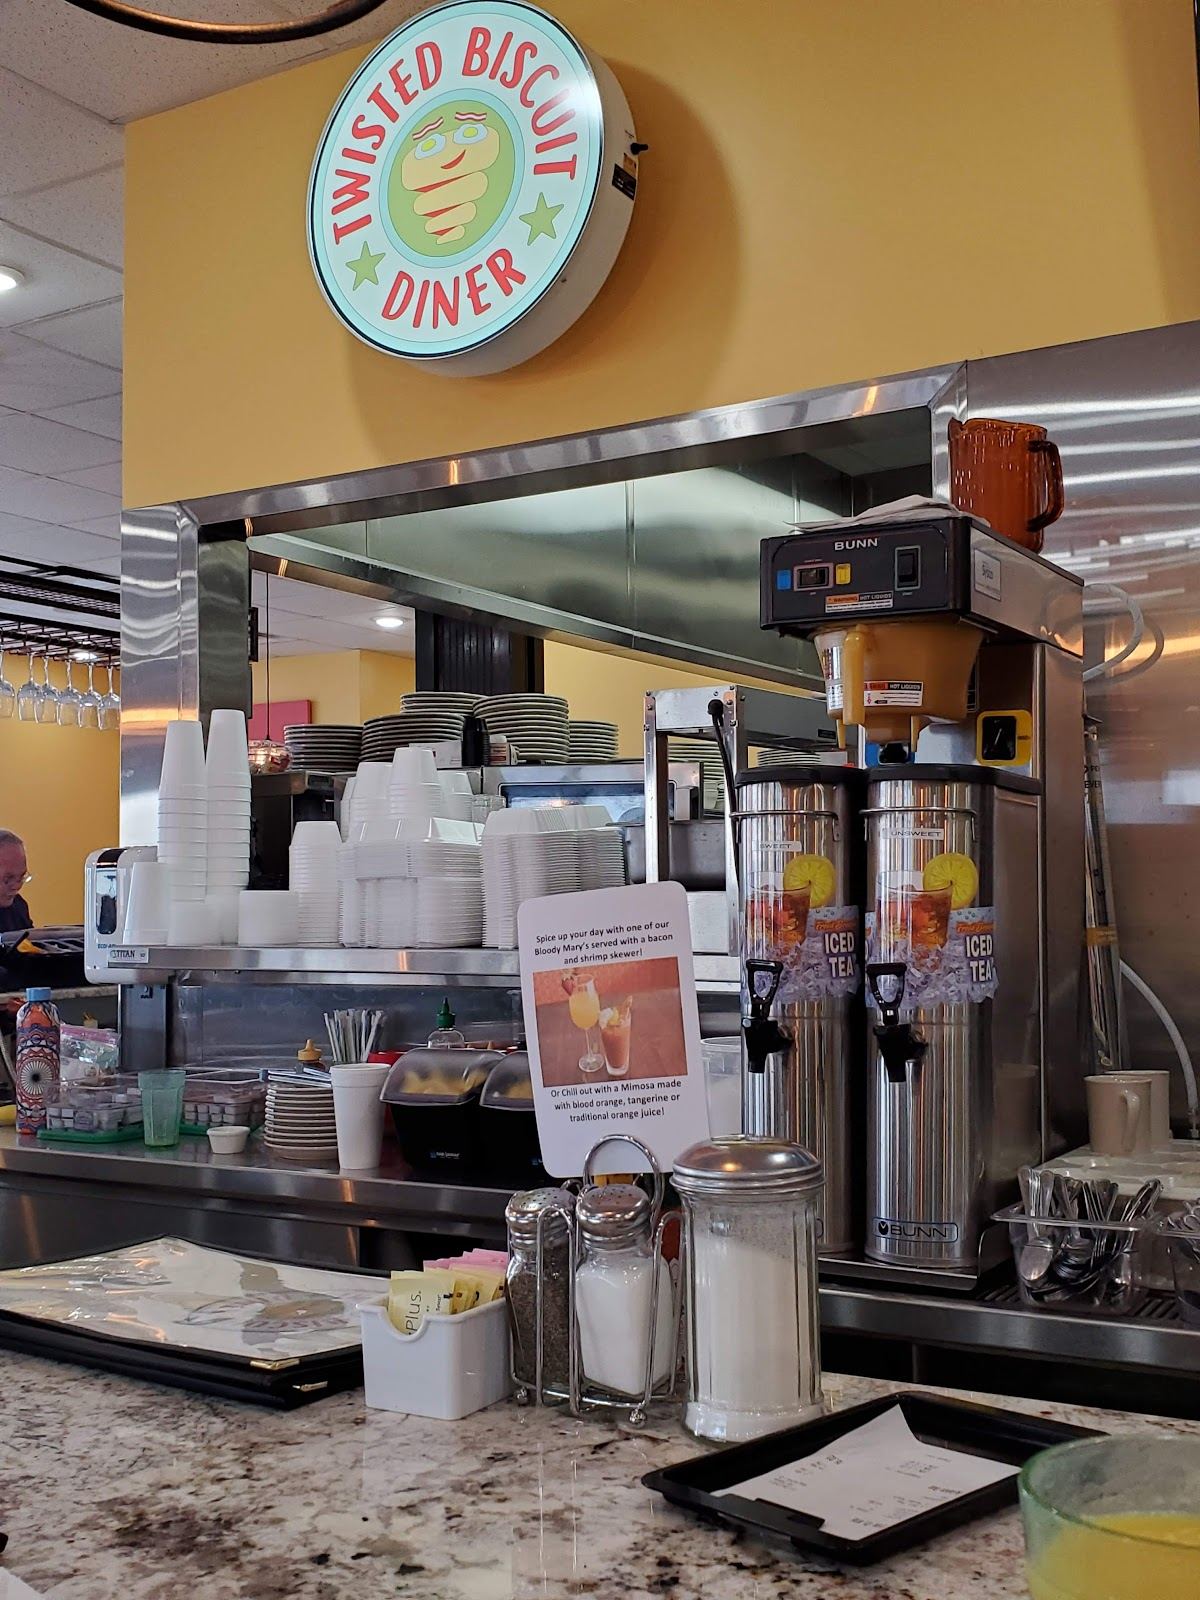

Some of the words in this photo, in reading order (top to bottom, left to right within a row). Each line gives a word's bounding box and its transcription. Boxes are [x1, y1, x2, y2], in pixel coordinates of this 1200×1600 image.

[331, 41, 442, 245] TWISTED
[462, 26, 578, 181] BISCUIT
[381, 248, 527, 329] DINER
[834, 537, 879, 551] BUNN
[890, 830, 942, 838] UNSWEET
[536, 934, 556, 944] Spice
[558, 932, 568, 942] up
[570, 930, 588, 941] your
[590, 927, 604, 938] day
[606, 925, 625, 935] with
[626, 924, 642, 932] one
[644, 921, 653, 930] of
[654, 921, 670, 929] our
[824, 931, 855, 955] ICED
[534, 945, 561, 956] Bloody
[562, 941, 590, 952] Mary's
[591, 938, 618, 949] served
[619, 936, 639, 945] with
[640, 936, 646, 944] a
[647, 933, 674, 942] bacon
[564, 955, 579, 965] and
[580, 953, 608, 963] shrimp
[609, 947, 643, 960] skewer!
[965, 933, 994, 958] ICED
[828, 956, 855, 979] TEA
[969, 958, 993, 983] TEA
[550, 1089, 560, 1098] Or
[561, 1087, 578, 1097] Chill
[579, 1087, 593, 1095] out
[594, 1084, 612, 1094] with
[613, 1085, 619, 1093] a
[621, 1082, 655, 1092] Mimosa
[657, 1078, 682, 1089] made
[554, 1101, 571, 1110] with
[572, 1099, 594, 1109] blood
[595, 1098, 626, 1108] orange,
[627, 1094, 669, 1105] tangerine
[569, 1110, 609, 1122] traditional
[610, 1111, 639, 1120] orange
[640, 1106, 665, 1119] juice!
[890, 1224, 947, 1238] BUNN
